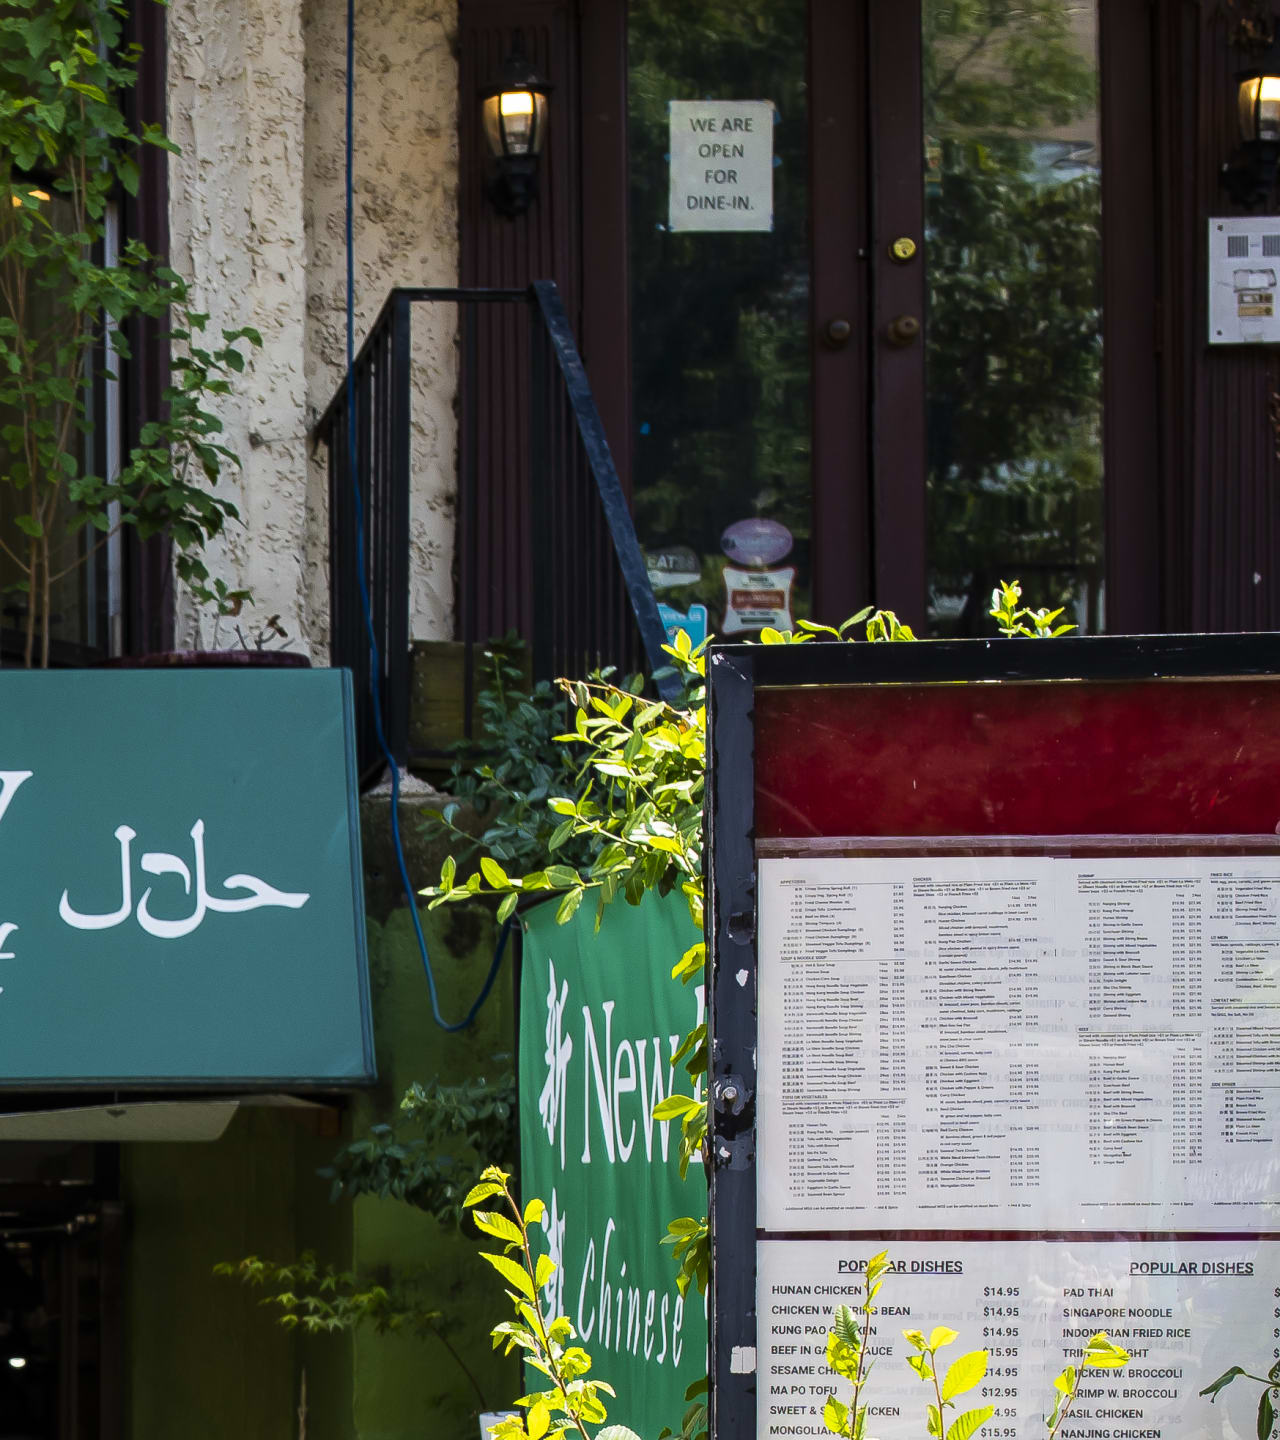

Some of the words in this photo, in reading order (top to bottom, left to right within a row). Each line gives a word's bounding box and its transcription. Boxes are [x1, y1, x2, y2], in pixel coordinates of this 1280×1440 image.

[689, 118, 718, 134] WE
[722, 117, 753, 133] ARE
[698, 143, 744, 160] OPEN
[704, 169, 738, 185] FOR
[687, 195, 755, 212] DINE-IN.
[59, 818, 310, 939] حلال
[581, 1000, 680, 1164] New
[910, 1261, 963, 1273] DISHES
[1130, 1262, 1198, 1274] POPULAR
[1201, 1262, 1254, 1274] DISHES
[577, 1217, 684, 1367] Chinese
[772, 1286, 811, 1295] HUNAN
[814, 1286, 862, 1295] CHICKEN
[983, 1287, 1020, 1297] $14.95
[1063, 1288, 1084, 1297] PAD
[1088, 1288, 1113, 1297] THAI
[772, 1306, 820, 1315] CHICKEN
[822, 1306, 834, 1315] W.
[881, 1306, 910, 1316] BEAN
[983, 1307, 1019, 1317] $14.95
[1063, 1308, 1126, 1318] SINGAPORE
[1128, 1308, 1173, 1318] NOODLE
[772, 1326, 801, 1335] KUNG
[805, 1326, 826, 1335] PAO
[983, 1327, 1019, 1337] $14.95
[1133, 1329, 1164, 1338] FRIED
[1166, 1329, 1191, 1338] RICE
[771, 1346, 797, 1355] BEEF
[800, 1346, 811, 1355] IN
[983, 1347, 1018, 1357] $15.95
[771, 1366, 815, 1375] SESAME
[1113, 1369, 1125, 1378] W.
[1128, 1369, 1182, 1378] BROCCOLI
[771, 1386, 787, 1395] MA
[791, 1386, 806, 1395] PO
[809, 1386, 837, 1395] TOFU
[982, 1387, 1017, 1397] $12.95
[1108, 1389, 1120, 1398] W.
[1123, 1389, 1177, 1398] BROCCOLI
[770, 1406, 807, 1415] SWEET
[1096, 1409, 1143, 1418] CHICKEN
[981, 1428, 1017, 1437] $15.95
[1061, 1429, 1110, 1439] NANJING
[1113, 1429, 1161, 1439] CHICKEN
